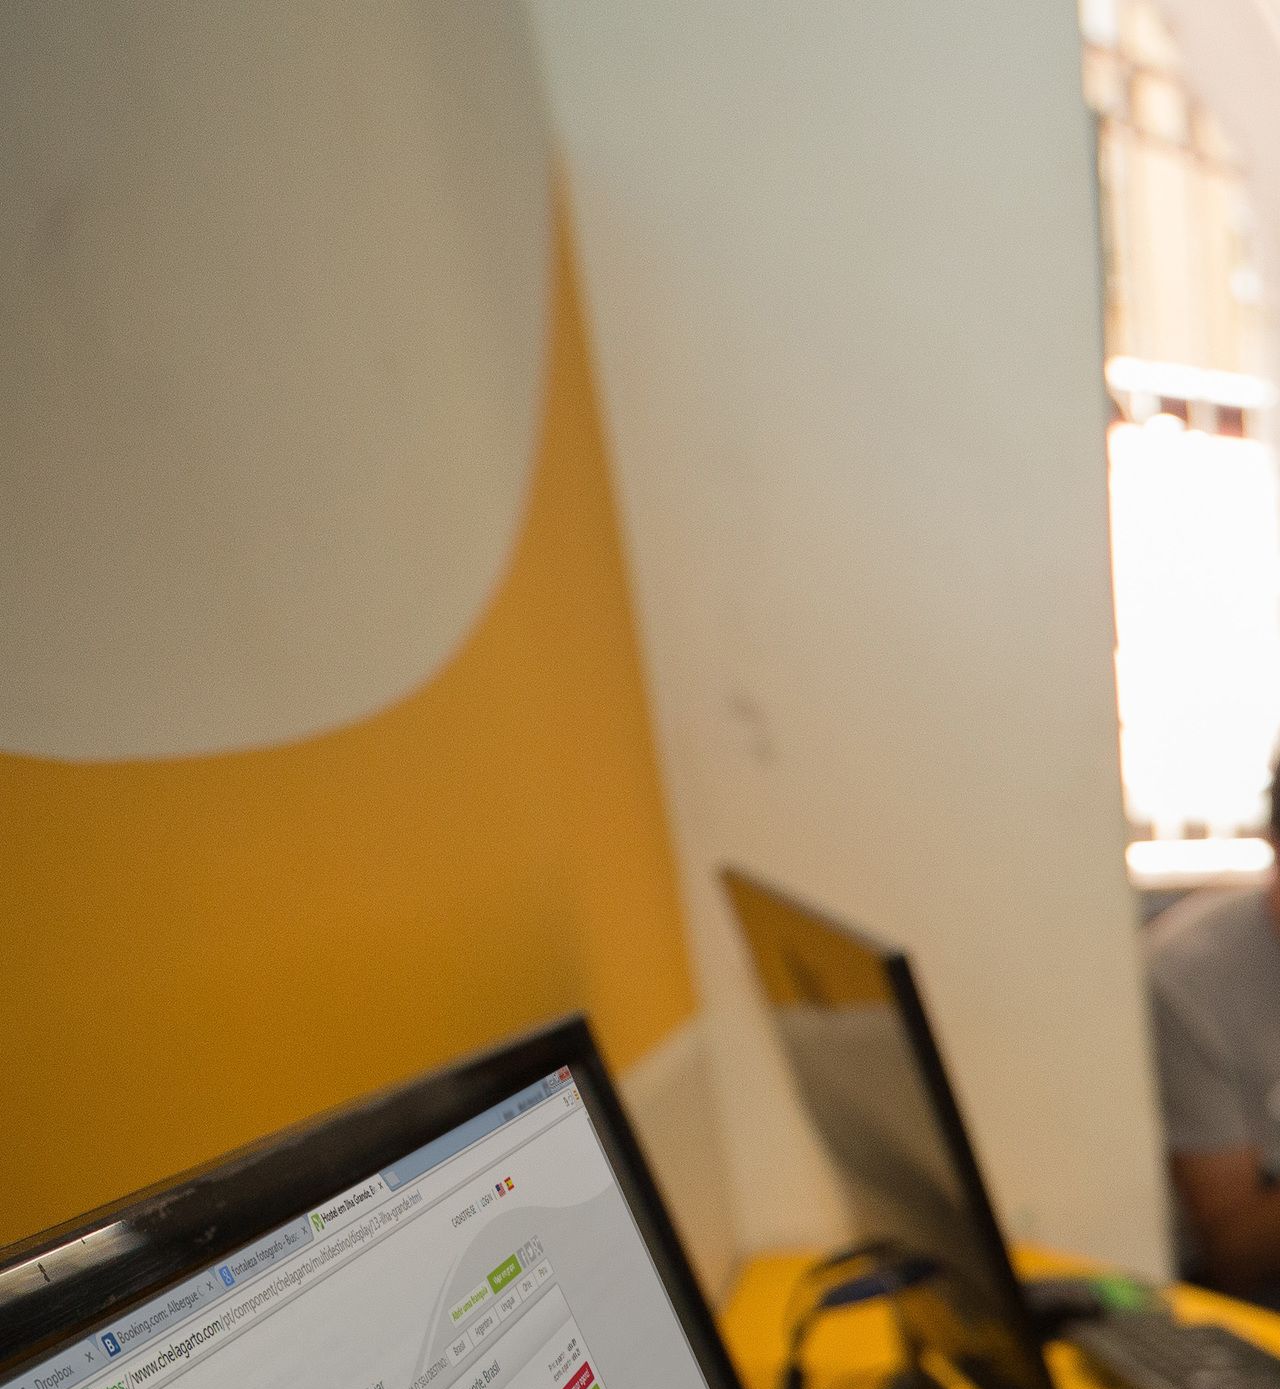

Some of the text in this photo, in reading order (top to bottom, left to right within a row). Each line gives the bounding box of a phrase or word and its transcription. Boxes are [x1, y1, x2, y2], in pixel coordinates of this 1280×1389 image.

[320, 1207, 339, 1223] Hostel
[336, 1202, 348, 1215] em
[343, 1199, 355, 1210] Ilha
[231, 1257, 258, 1276] fortaleza
[255, 1240, 283, 1261] fotografo
[116, 1292, 199, 1344] Booking.com: Albergue
[482, 1360, 500, 1383] Brasil
